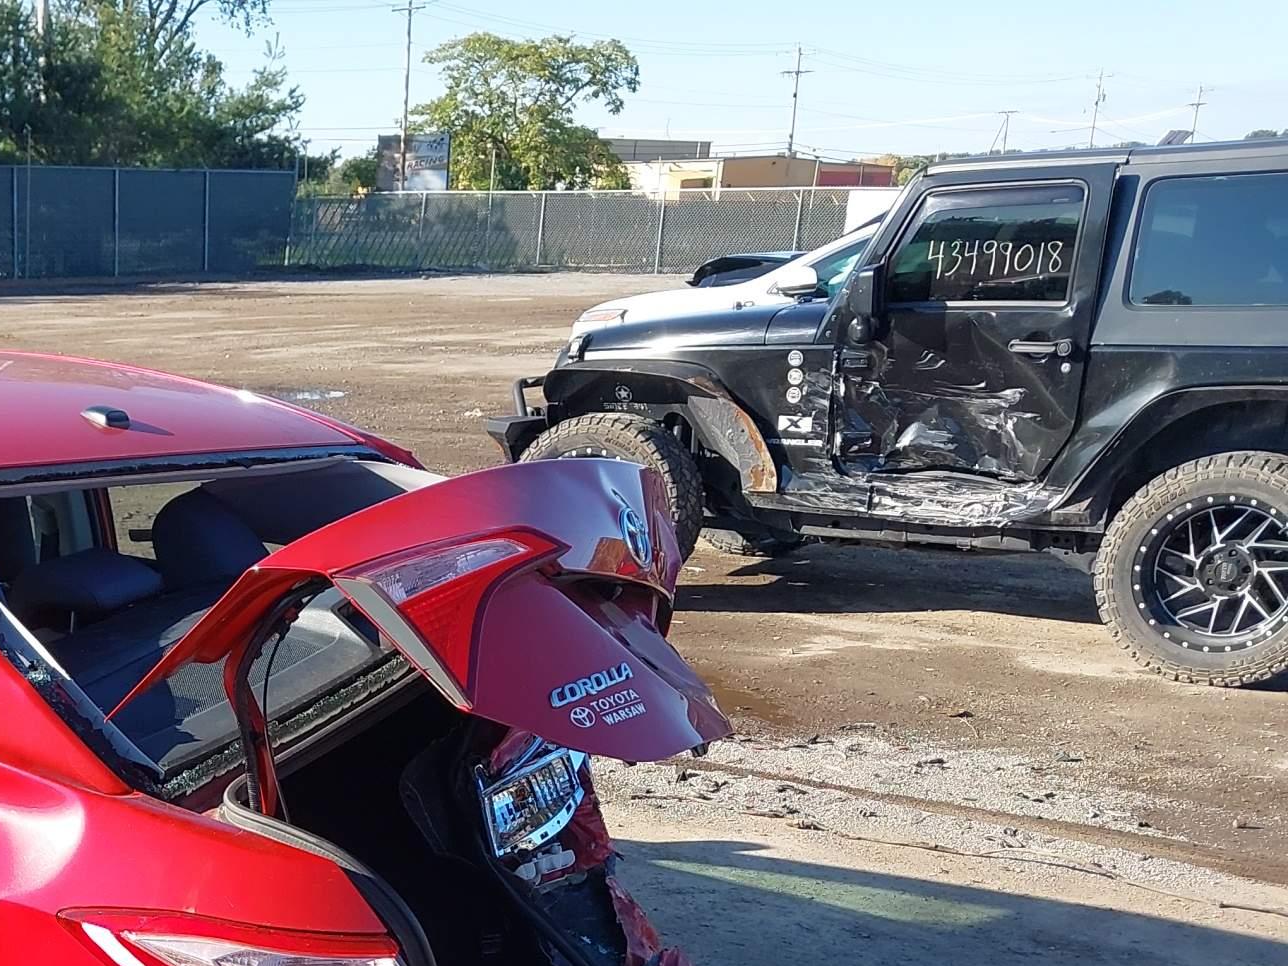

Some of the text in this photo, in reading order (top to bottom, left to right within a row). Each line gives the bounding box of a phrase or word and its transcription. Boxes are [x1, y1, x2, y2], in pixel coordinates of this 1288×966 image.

[927, 240, 1064, 280] 43499018
[550, 661, 634, 708] COROLLA
[590, 688, 640, 712] TOYOTA
[602, 703, 647, 726] WARSAW
